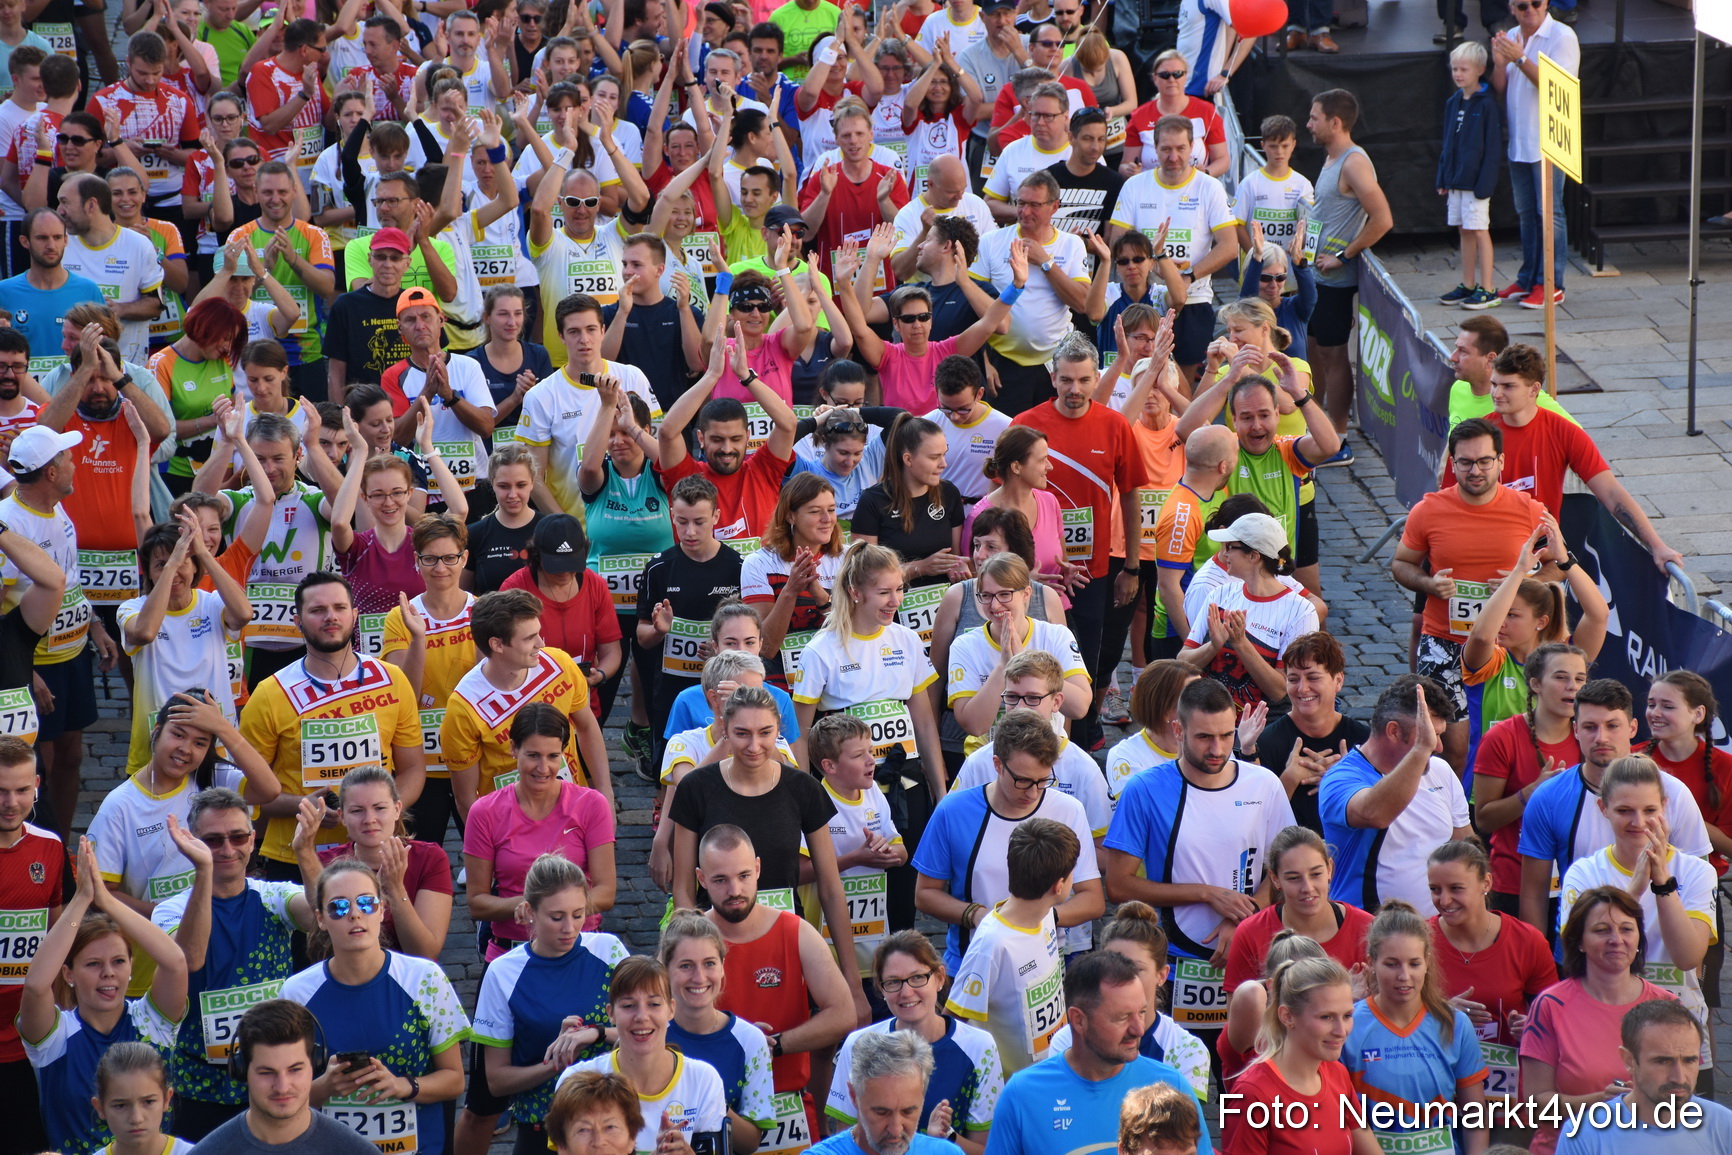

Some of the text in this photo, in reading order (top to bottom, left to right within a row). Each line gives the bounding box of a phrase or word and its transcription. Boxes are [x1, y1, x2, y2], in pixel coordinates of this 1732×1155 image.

[49, 36, 71, 47] 128
[1549, 79, 1570, 119] FUN
[1107, 122, 1121, 137] 25
[1549, 113, 1571, 155] RUN
[144, 154, 162, 168] 97
[1258, 210, 1294, 220] BOCK
[687, 247, 712, 262] 190
[1166, 244, 1187, 258] 38
[572, 263, 613, 274] BOCK
[573, 277, 615, 293] 5282
[972, 436, 983, 444] 20
[606, 499, 628, 512] H&S
[1062, 511, 1089, 524] CK
[1064, 527, 1088, 543] 28
[1168, 501, 1192, 555] BOCK
[79, 552, 129, 565] BOCK
[79, 570, 132, 586] 5276
[85, 591, 123, 599] THOMAS
[621, 595, 640, 603] LIS
[55, 603, 89, 631] 5243
[1457, 602, 1483, 618] 51
[257, 625, 297, 635] Reinhard
[677, 620, 712, 634] BOC
[676, 639, 704, 657] 50
[880, 647, 892, 656] 20
[687, 662, 710, 670] LUC
[350, 694, 400, 713] BÖGL
[850, 703, 899, 717] BOCK
[3, 710, 29, 734] 77
[309, 721, 372, 736] BOCK
[870, 723, 907, 743] 069
[311, 738, 370, 763] 5101
[319, 767, 356, 778] SIEM
[1112, 763, 1132, 781] 20
[864, 811, 876, 822] 20
[137, 823, 164, 836] BOCK
[843, 875, 883, 892] OCK
[847, 898, 879, 919] 171
[0, 936, 39, 959] 188
[1019, 961, 1038, 976] BOCK
[965, 979, 983, 999] 20
[1181, 984, 1228, 1007] 505
[215, 985, 279, 1011] BOCK
[1186, 1011, 1228, 1023] DOMIN
[1384, 1052, 1416, 1061] Neumarkt
[668, 1104, 684, 1117] 20
[334, 1109, 407, 1136] 5213
[757, 1119, 803, 1148] 274
[1379, 1132, 1444, 1154] BOCK
